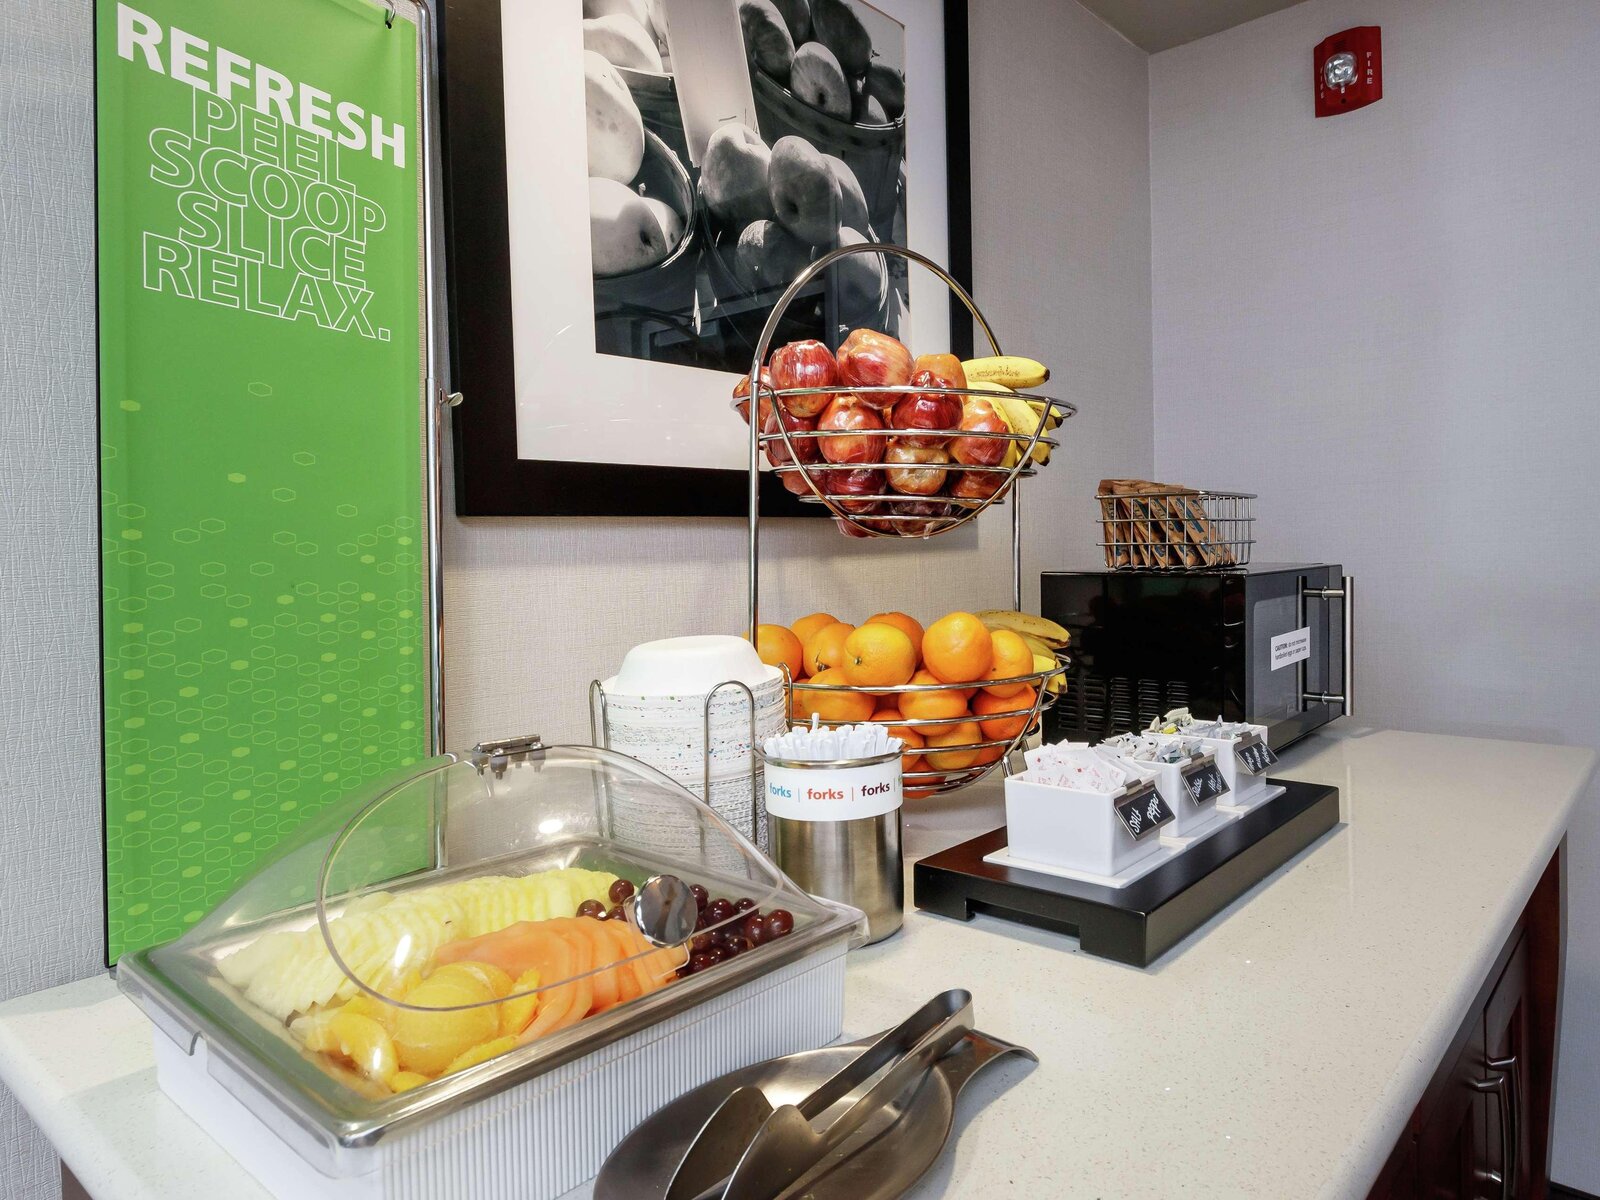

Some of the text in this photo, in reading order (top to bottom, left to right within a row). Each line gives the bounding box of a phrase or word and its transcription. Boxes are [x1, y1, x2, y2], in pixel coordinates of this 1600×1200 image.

[117, 2, 405, 169] REFRESH
[193, 86, 356, 195] PEEL
[149, 127, 386, 245] SCOOP
[177, 191, 366, 291] SLICE
[143, 231, 391, 342] RELAX.
[769, 782, 890, 800] forks forks forks
